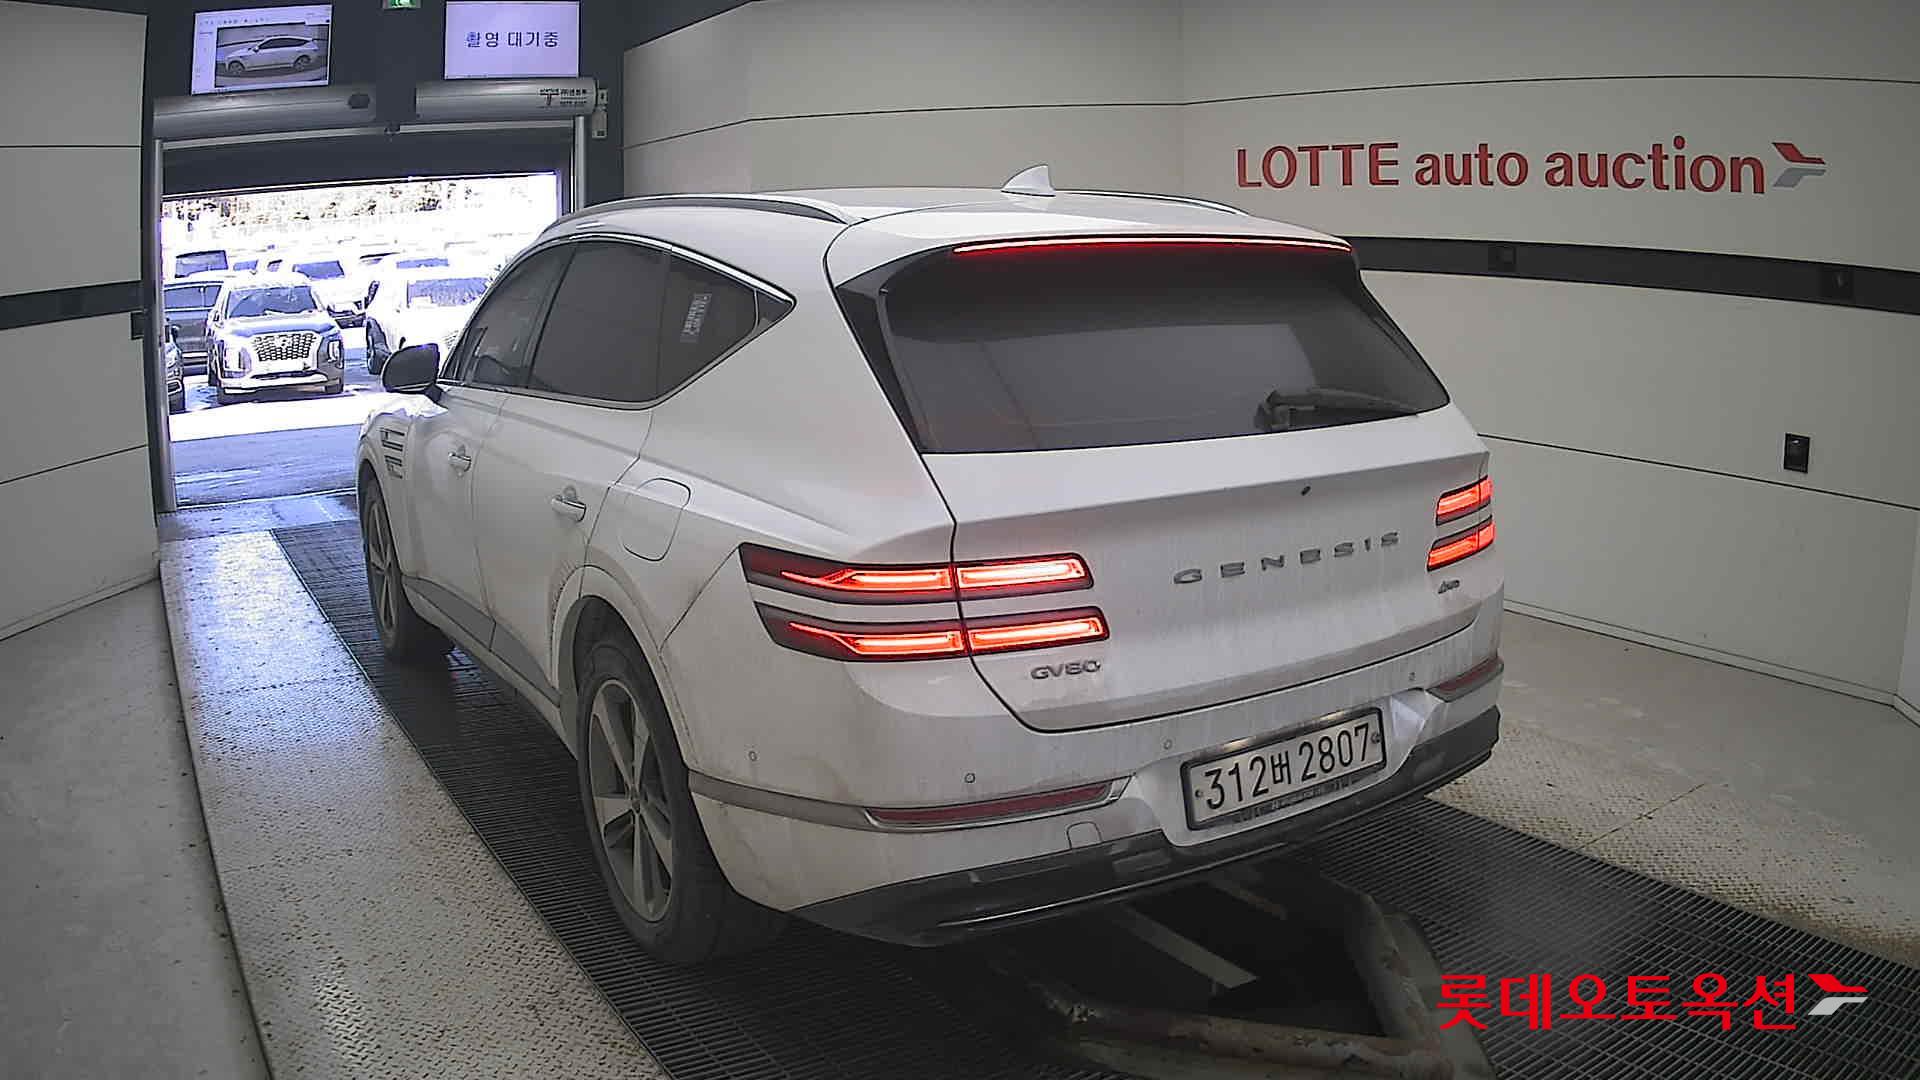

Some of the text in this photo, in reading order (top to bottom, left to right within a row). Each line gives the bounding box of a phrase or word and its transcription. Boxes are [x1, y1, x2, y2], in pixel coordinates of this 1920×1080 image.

[507, 31, 559, 48] 대기중
[1236, 135, 1765, 195] LOTTE auto auction
[1173, 531, 1399, 585] GENESIS
[1031, 660, 1101, 680] GV80
[1204, 722, 1370, 810] 312버 2807
